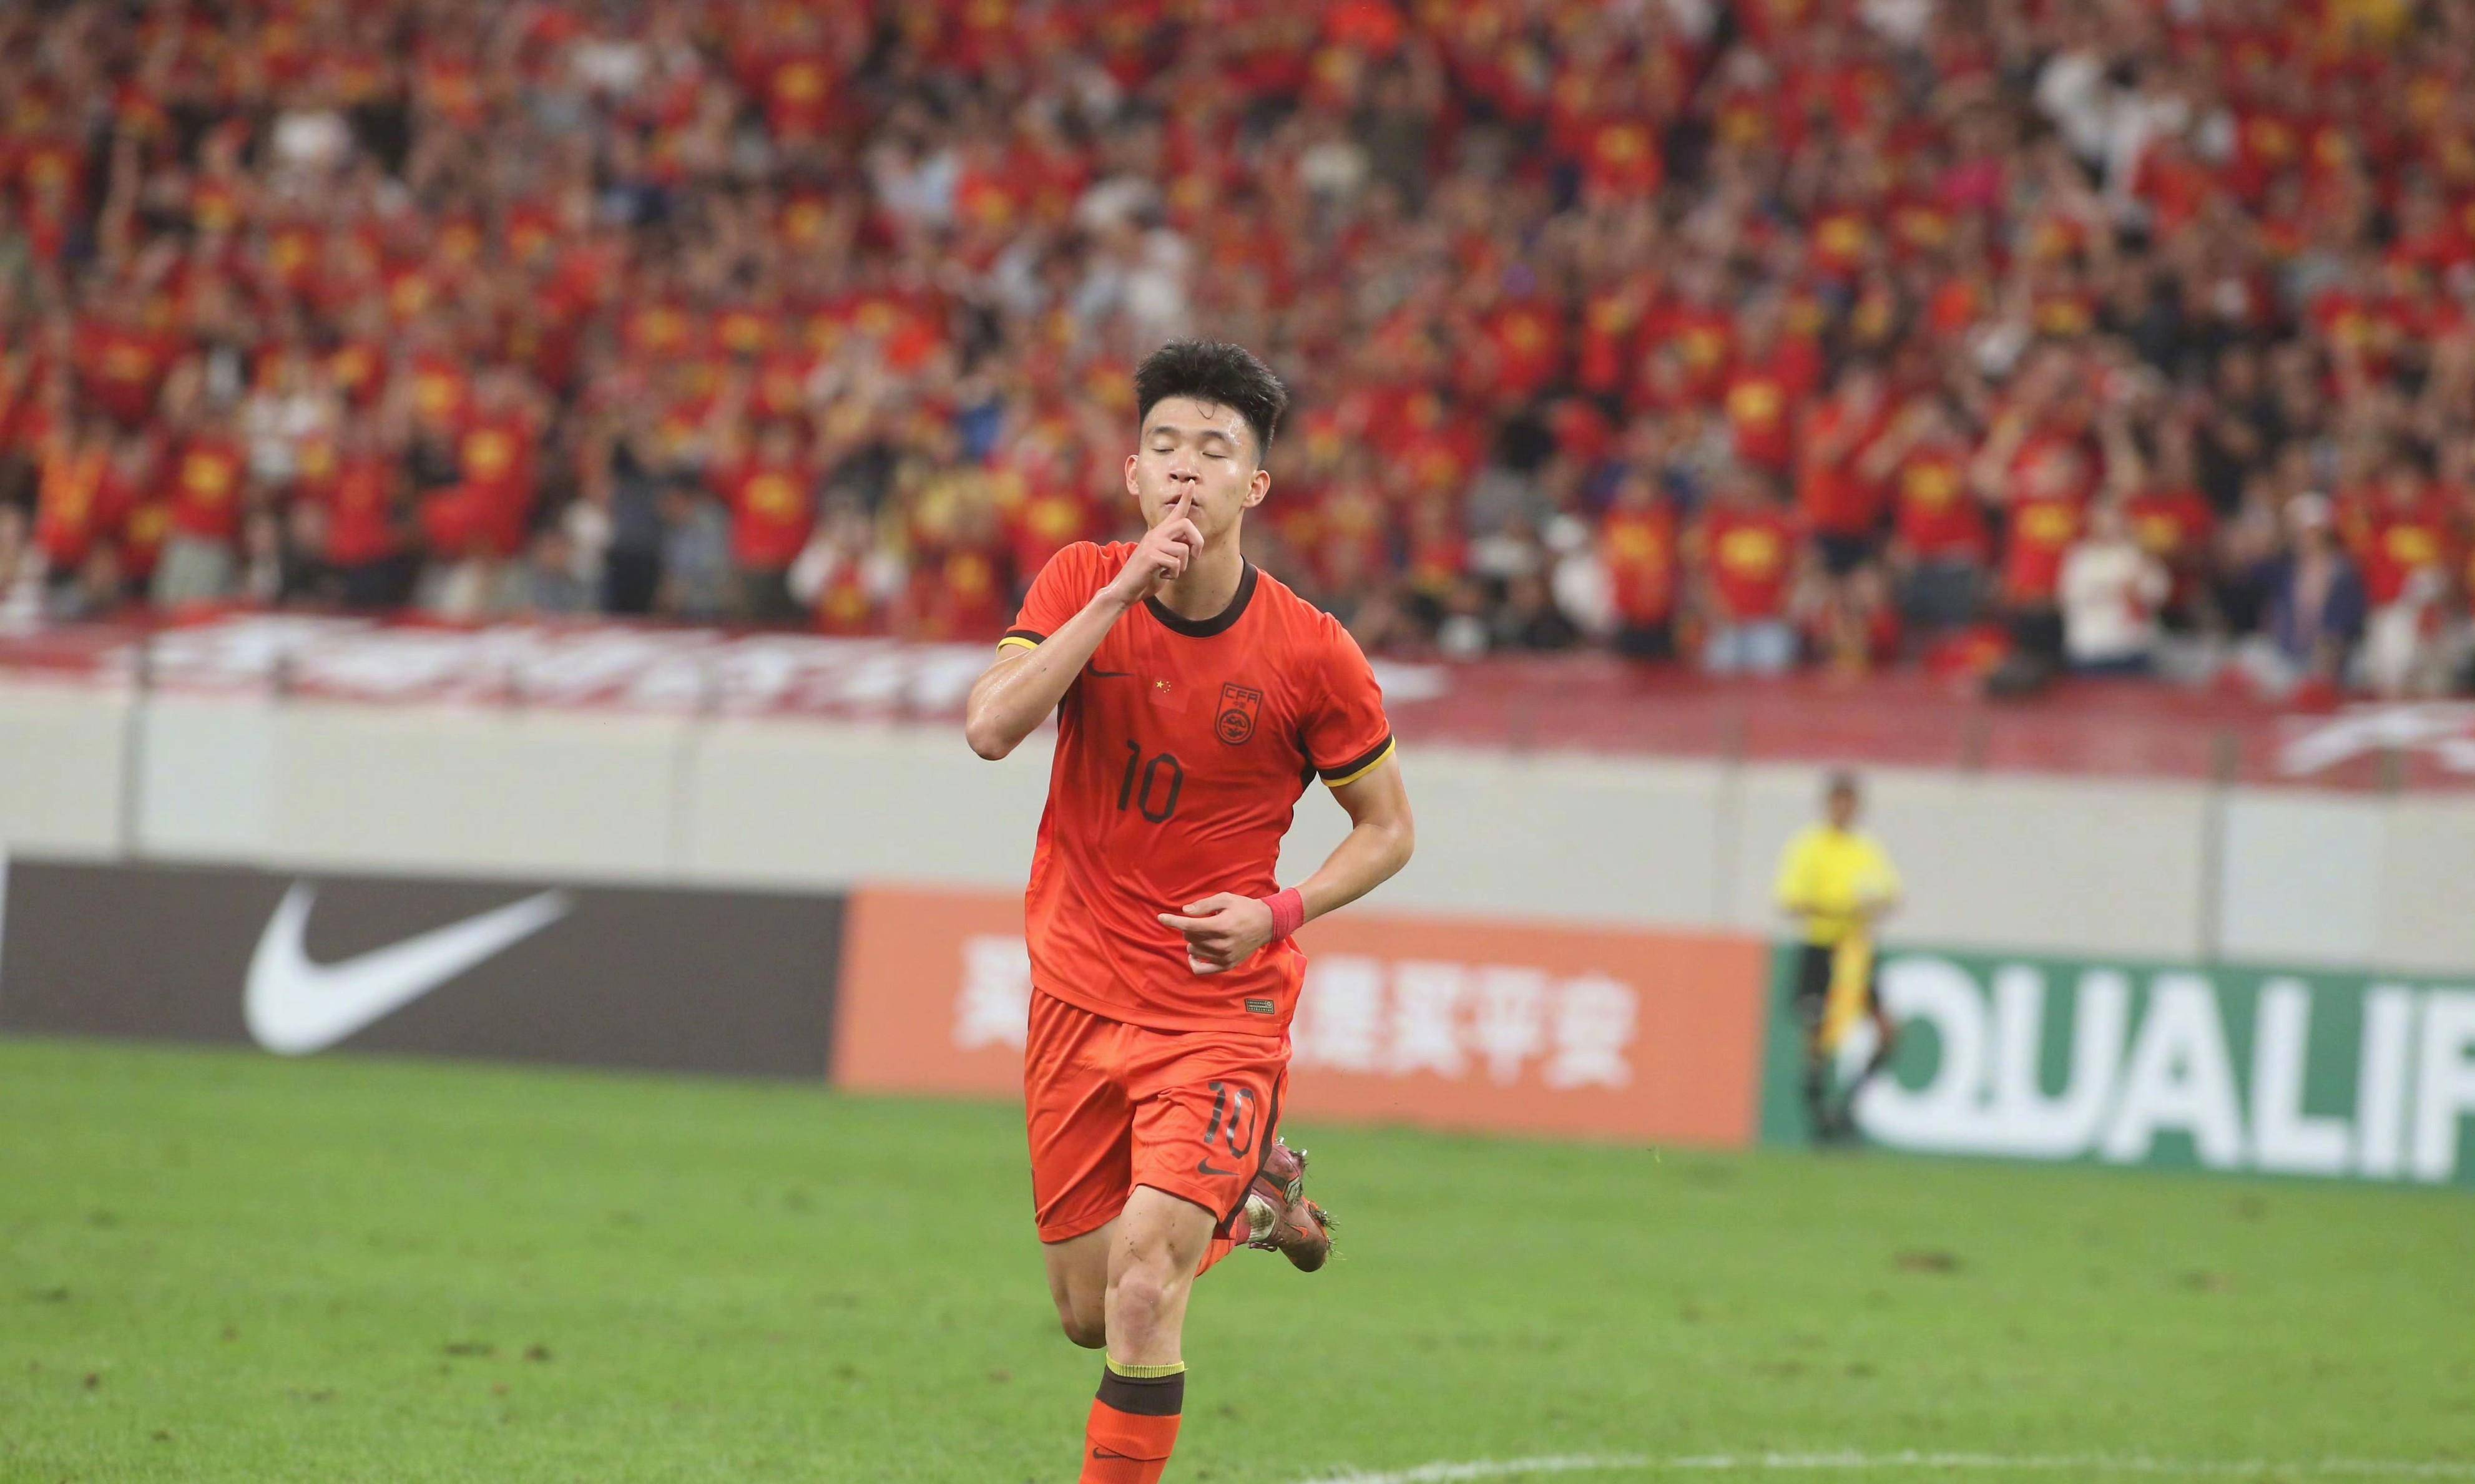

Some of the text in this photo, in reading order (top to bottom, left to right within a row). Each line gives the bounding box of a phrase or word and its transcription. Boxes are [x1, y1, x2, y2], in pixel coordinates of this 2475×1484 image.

[1225, 687, 1259, 704] CFA
[1117, 738, 1184, 824] 10
[1203, 1081, 1256, 1159] 10
